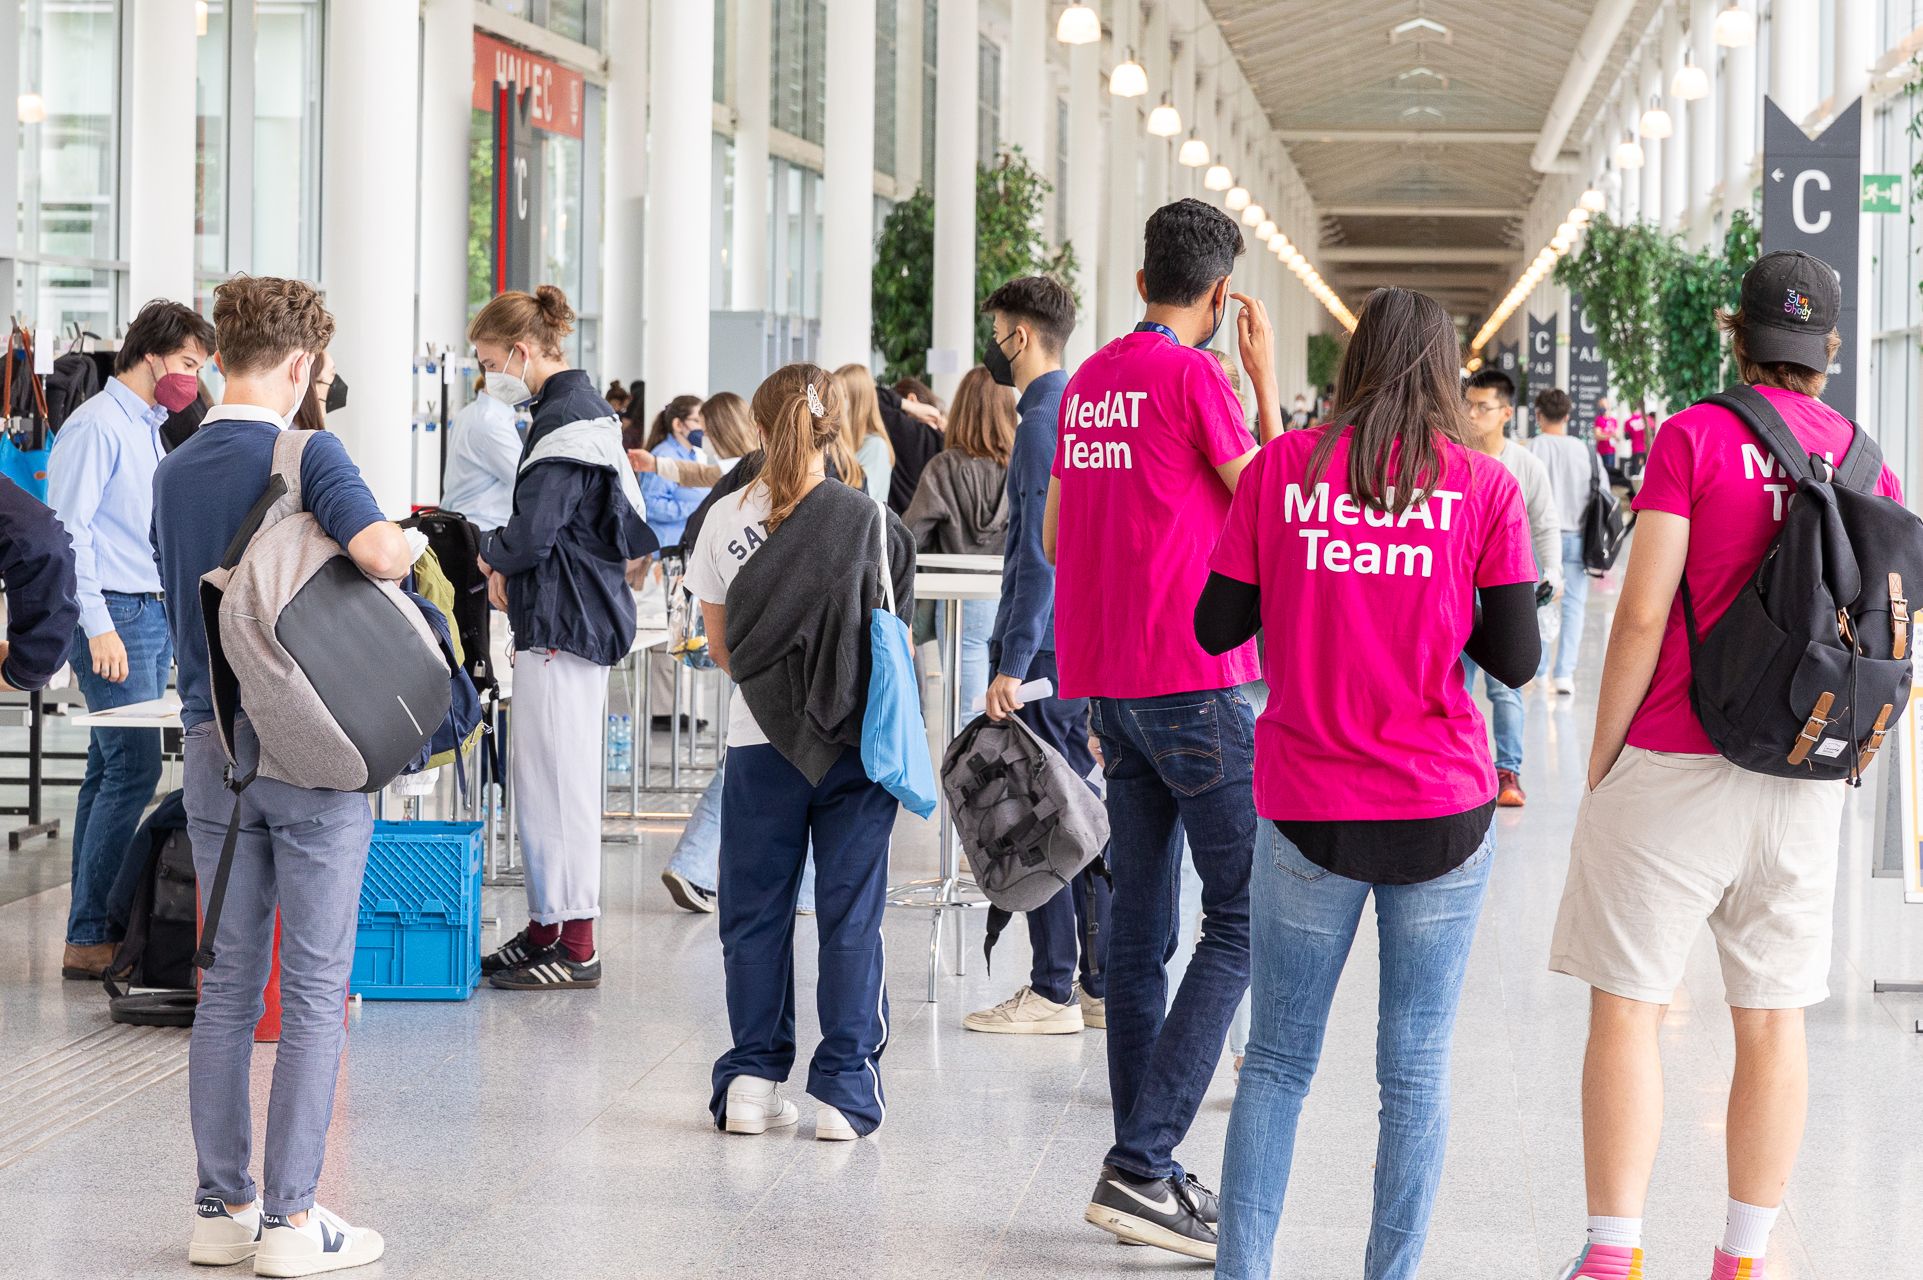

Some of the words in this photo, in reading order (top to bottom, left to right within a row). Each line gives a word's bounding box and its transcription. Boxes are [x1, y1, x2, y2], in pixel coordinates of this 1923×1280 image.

[517, 157, 528, 221] C
[1792, 169, 1832, 235] C
[1535, 331, 1551, 355] C
[1064, 390, 1148, 429] MedAT
[1063, 433, 1133, 470] Team
[1284, 482, 1463, 531] MedAT
[1298, 529, 1433, 577] Team
[199, 1204, 219, 1213] VEJA
